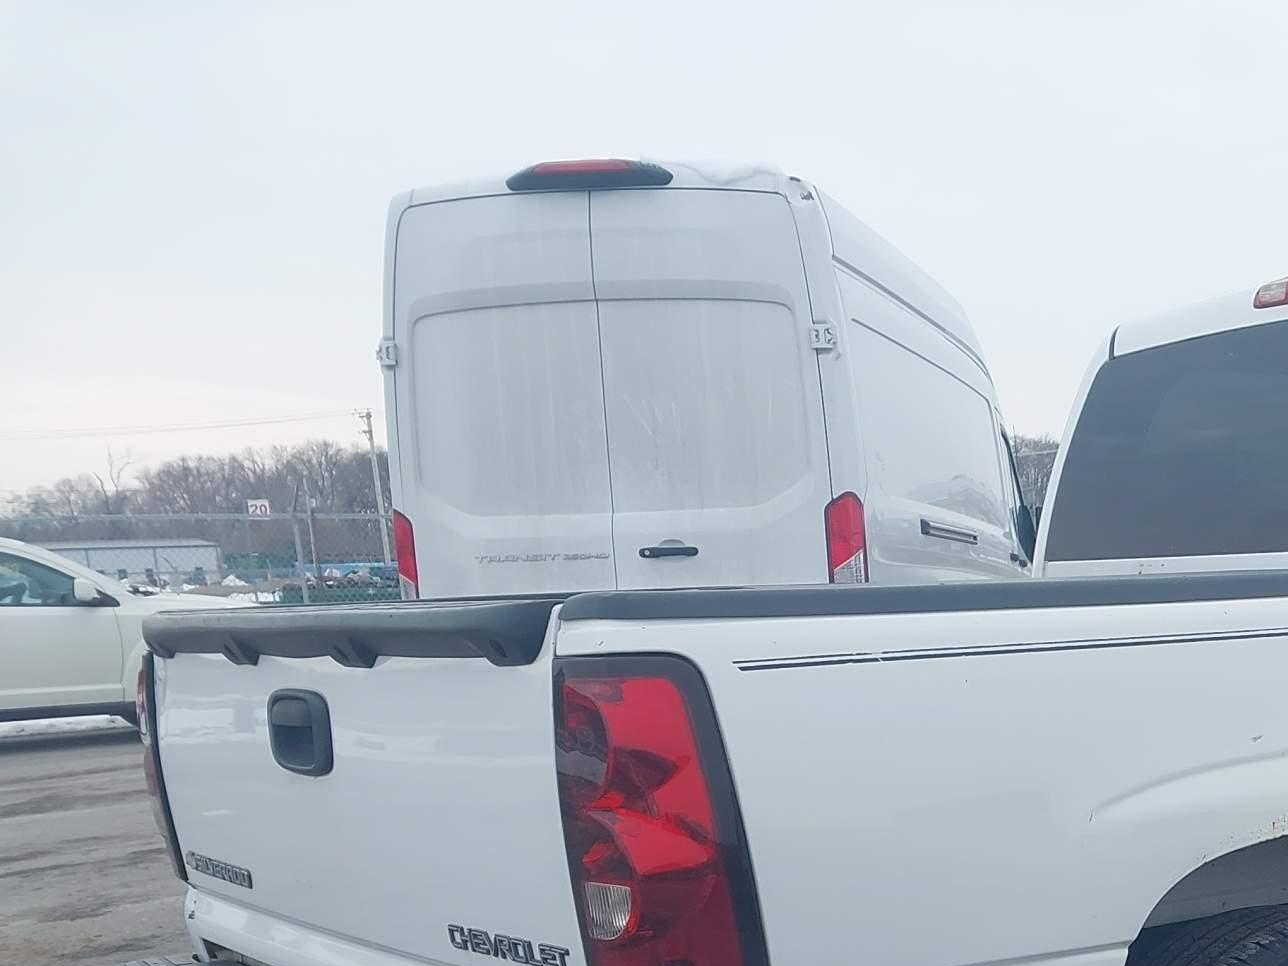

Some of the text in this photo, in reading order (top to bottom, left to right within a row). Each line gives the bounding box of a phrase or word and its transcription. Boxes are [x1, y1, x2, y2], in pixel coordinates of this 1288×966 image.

[250, 503, 268, 516] 20
[474, 552, 560, 564] TRANSIT
[188, 851, 252, 888] SILVERADO
